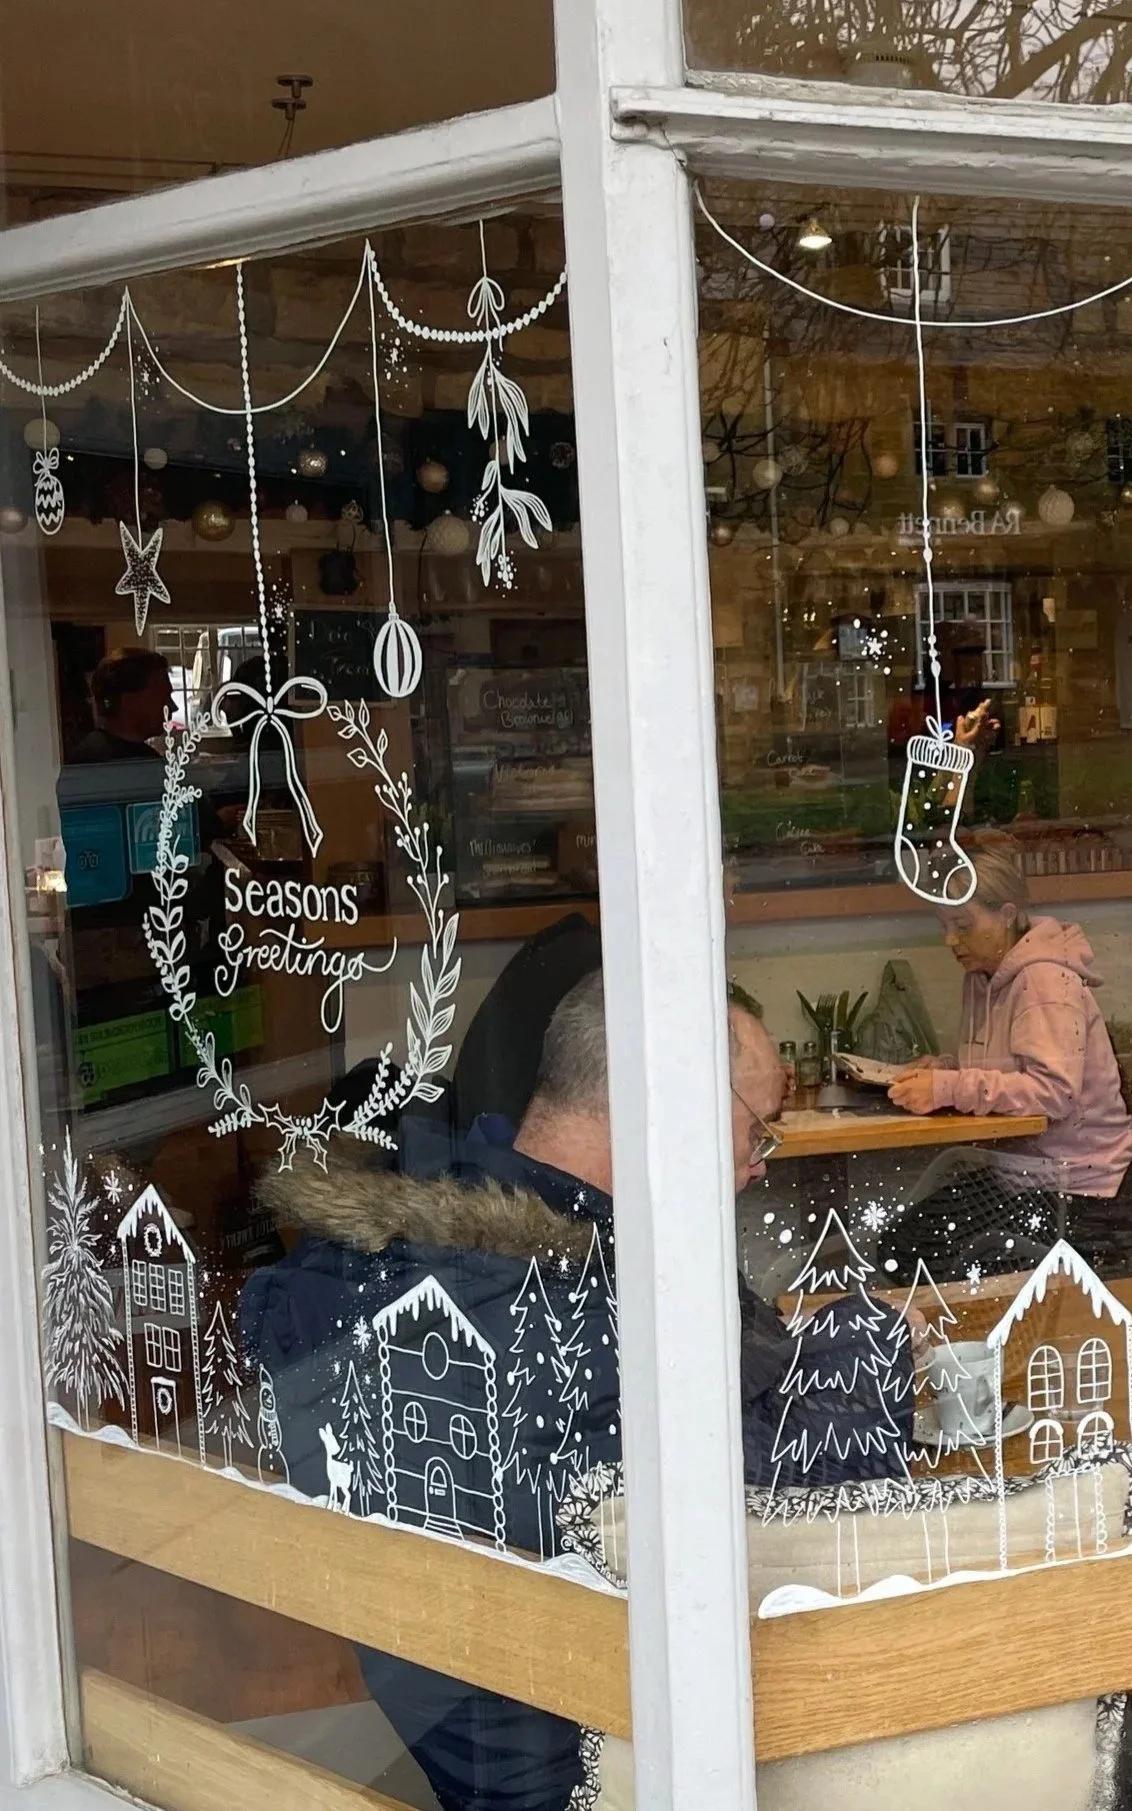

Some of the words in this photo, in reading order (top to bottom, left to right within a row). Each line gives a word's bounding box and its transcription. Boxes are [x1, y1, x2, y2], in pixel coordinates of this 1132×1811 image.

[483, 688, 553, 710] Chocolate
[224, 867, 359, 926] Seasons
[214, 922, 398, 1033] Greetings
